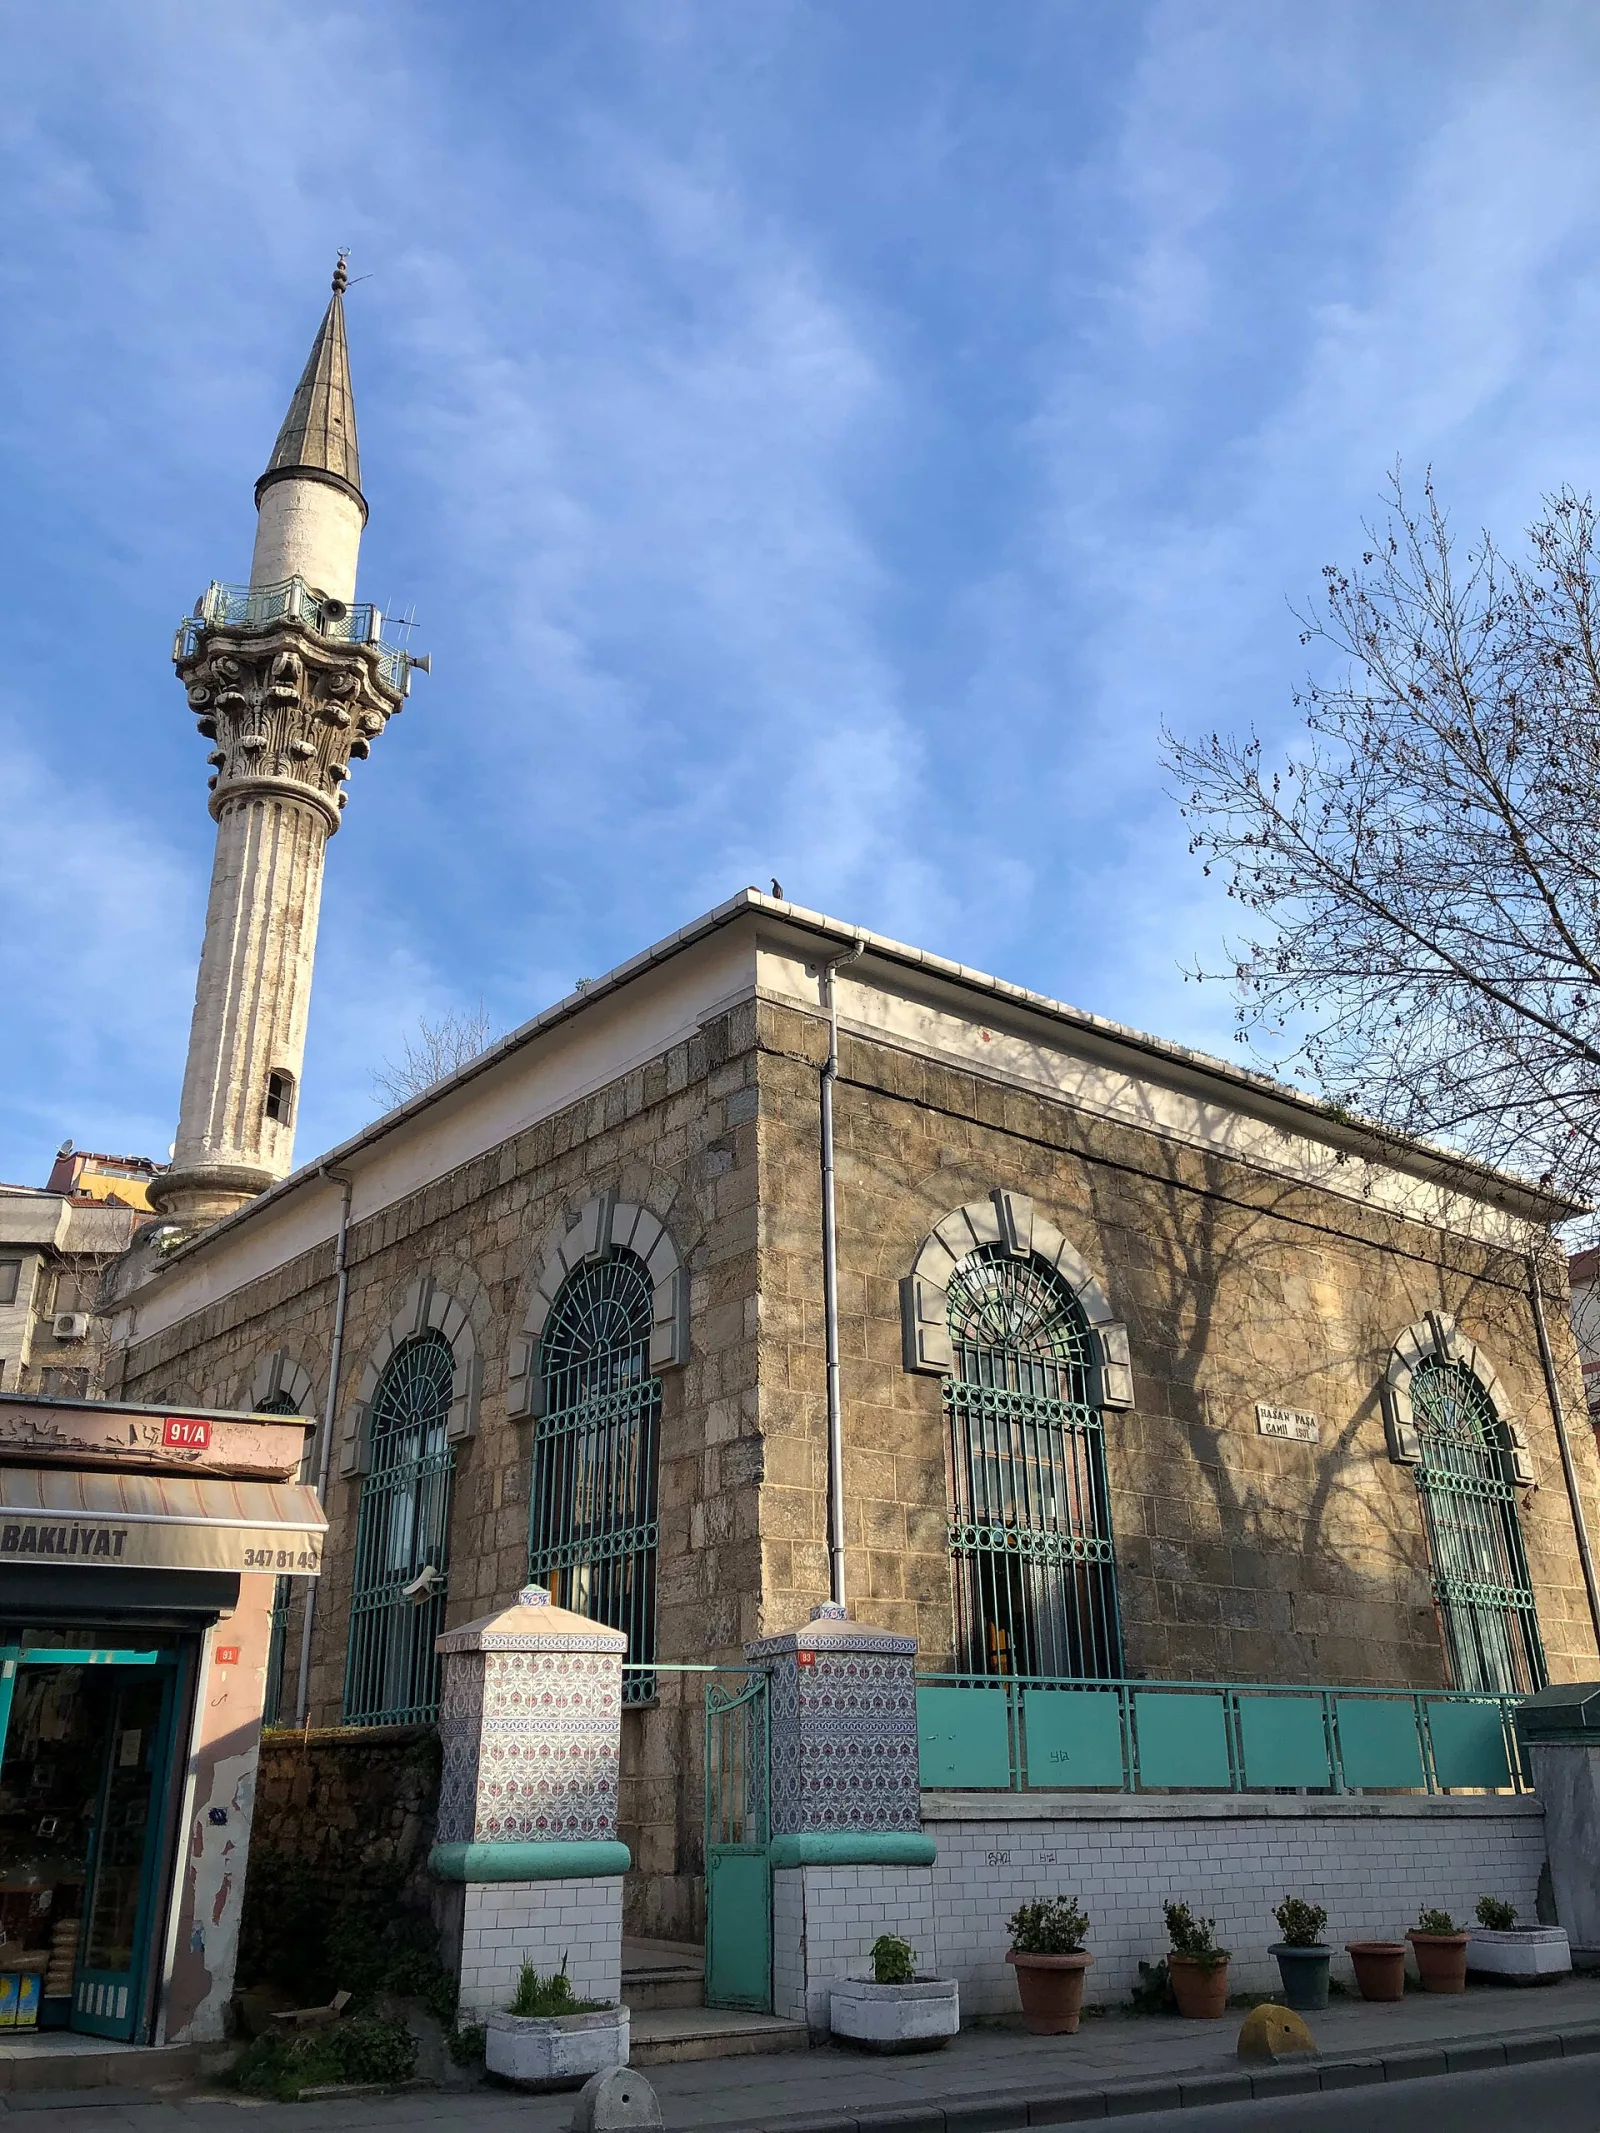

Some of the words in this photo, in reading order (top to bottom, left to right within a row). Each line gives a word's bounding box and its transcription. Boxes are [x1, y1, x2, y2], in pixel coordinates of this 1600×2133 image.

[1260, 1408, 1290, 1421] HASAN
[1295, 1414, 1316, 1429] PAŞA
[170, 1423, 205, 1443] 91/A
[0, 1522, 128, 1556] BAKLİYAT
[244, 1548, 273, 1567] 347
